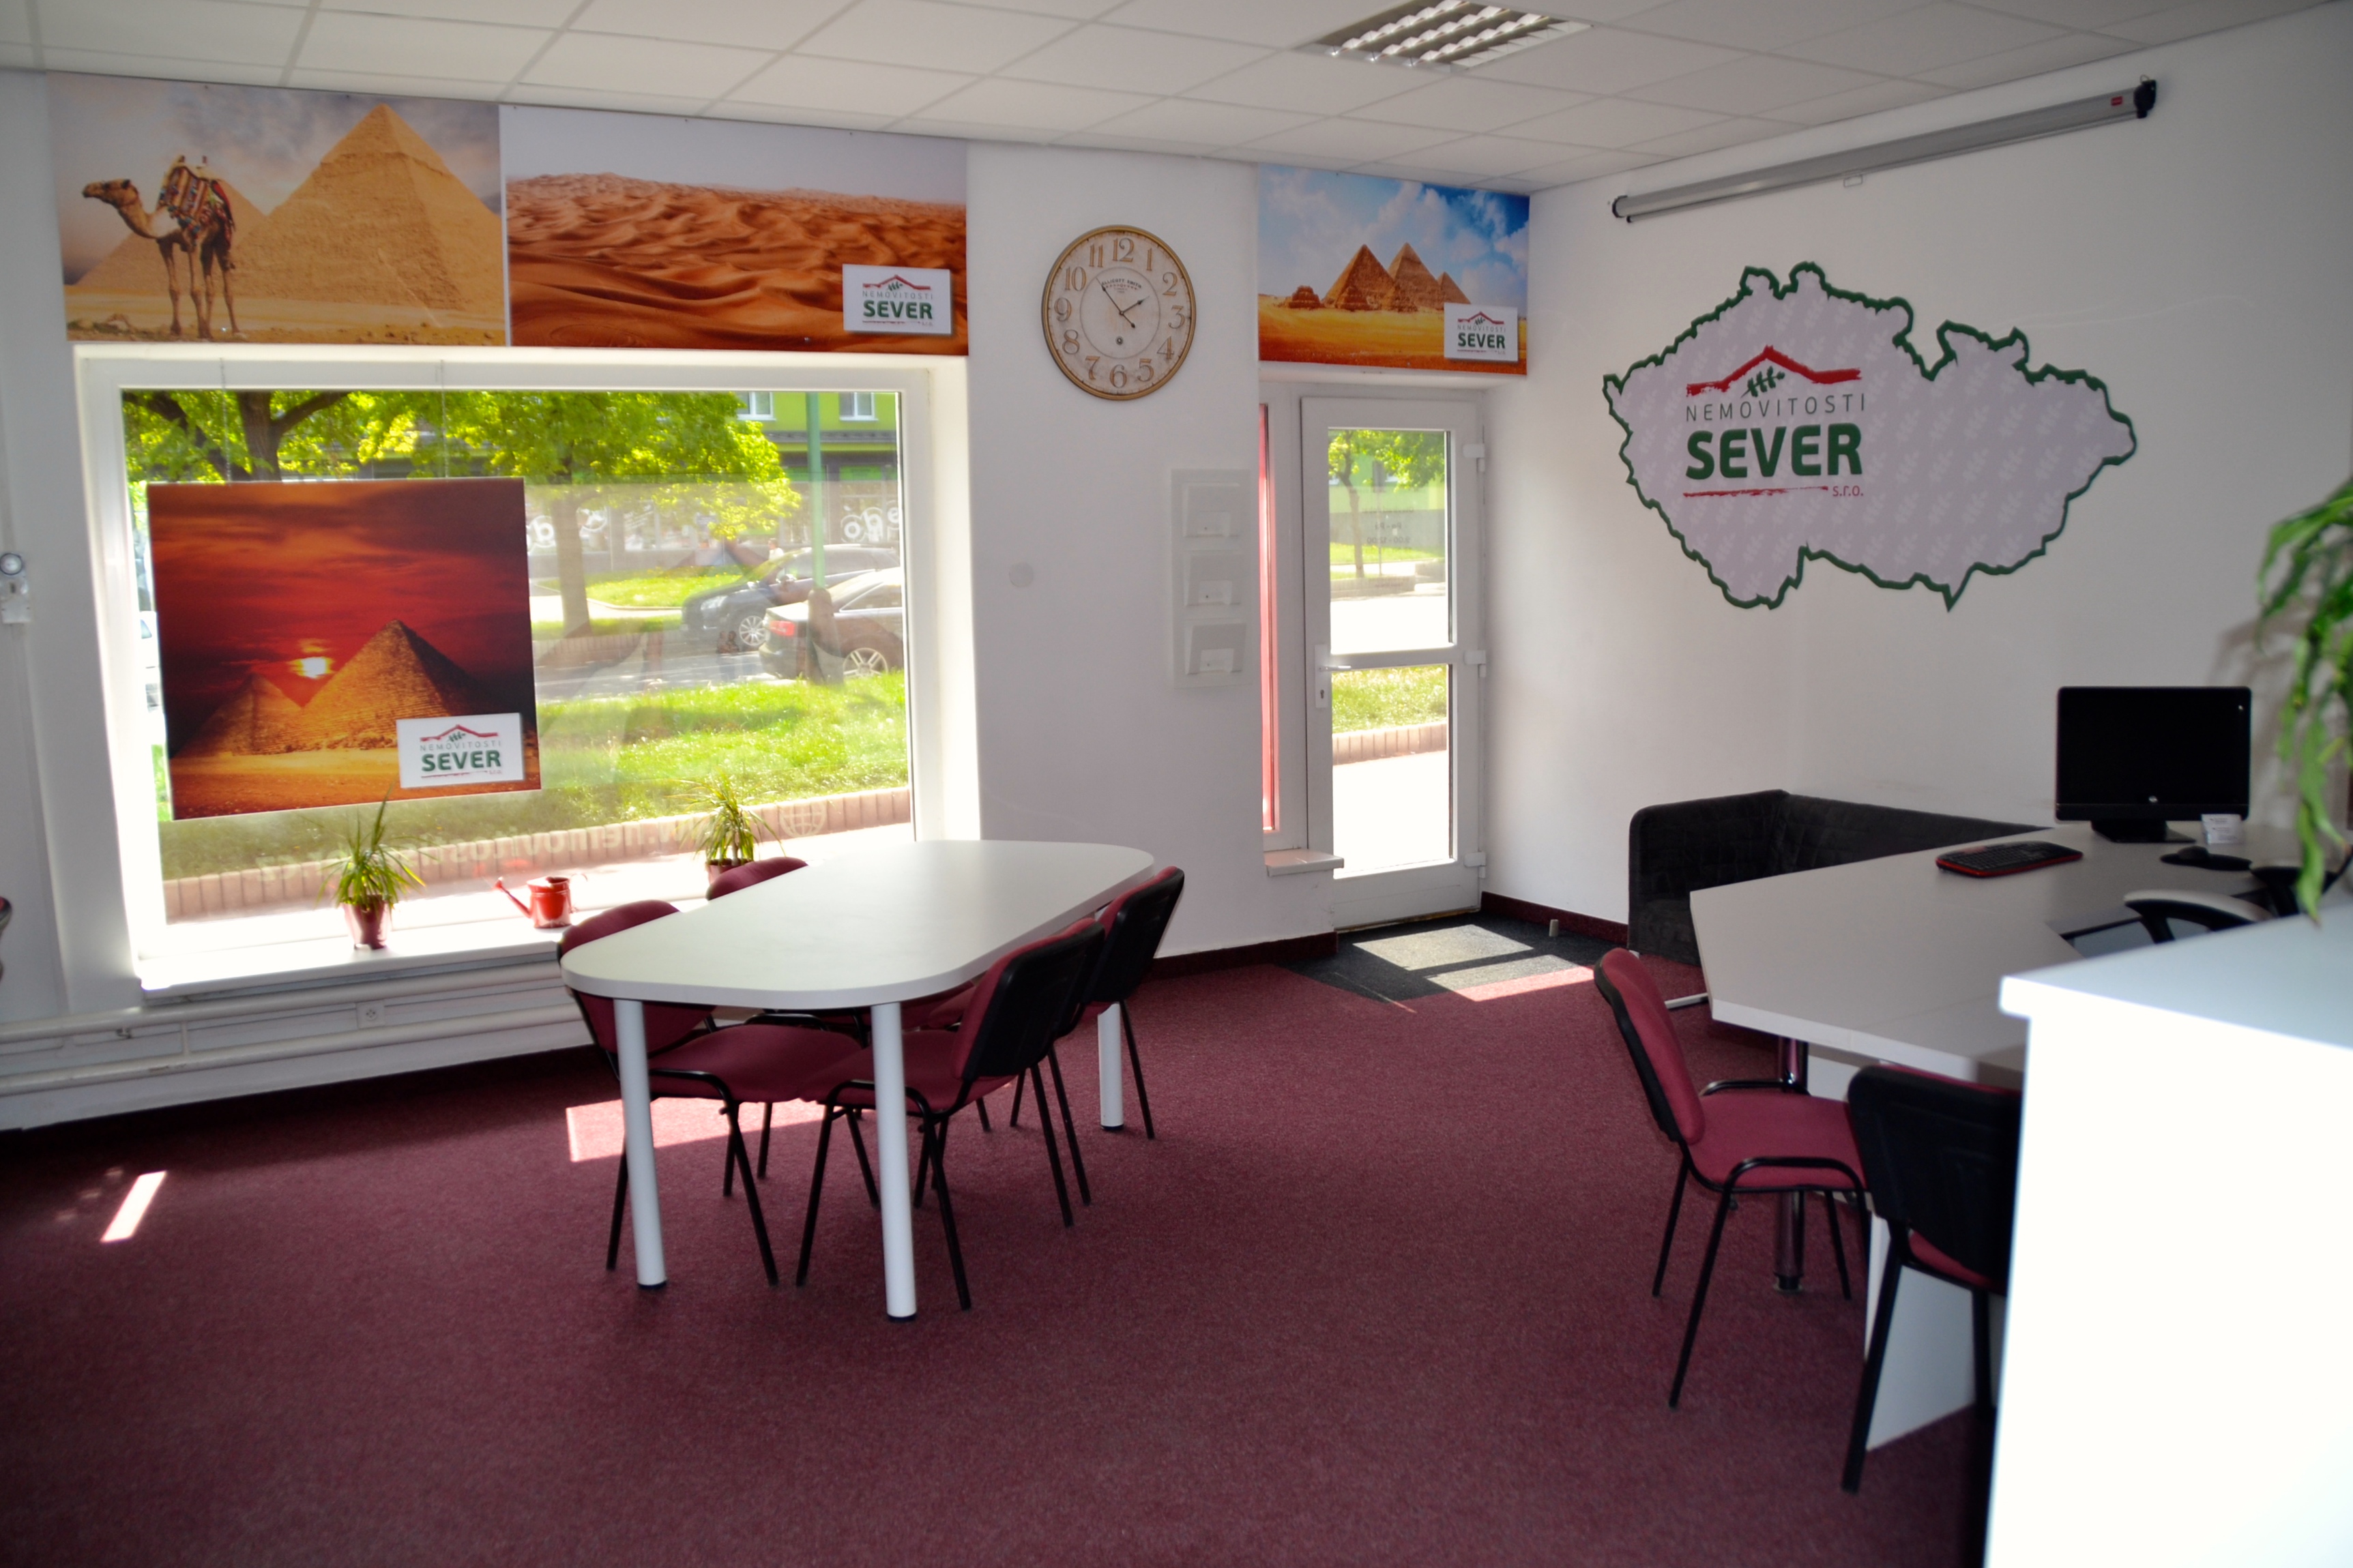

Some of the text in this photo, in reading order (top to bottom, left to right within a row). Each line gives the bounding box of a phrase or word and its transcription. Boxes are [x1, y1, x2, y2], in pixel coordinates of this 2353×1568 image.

[1089, 243, 1103, 267] 11
[1112, 237, 1135, 263] 12
[1146, 248, 1153, 271] 1
[1065, 266, 1087, 291] 10
[1163, 271, 1178, 296] 2
[862, 291, 933, 300] NEMOVITOSTI
[863, 299, 933, 319] SEVER
[1054, 297, 1072, 321] 9
[1168, 305, 1185, 329] 3
[1062, 329, 1080, 354] 8
[1156, 336, 1174, 360] 4
[1458, 332, 1506, 349] SEVER
[1085, 355, 1100, 380] 7
[1110, 364, 1127, 388] 6
[1137, 358, 1154, 382] 5
[1686, 393, 1865, 421] NEMOVITOSTI
[1685, 422, 1862, 480] SEVER
[1832, 485, 1864, 497] s.r.o.
[420, 740, 501, 752] NEMOVITOSTI
[422, 750, 501, 772] SEVER
